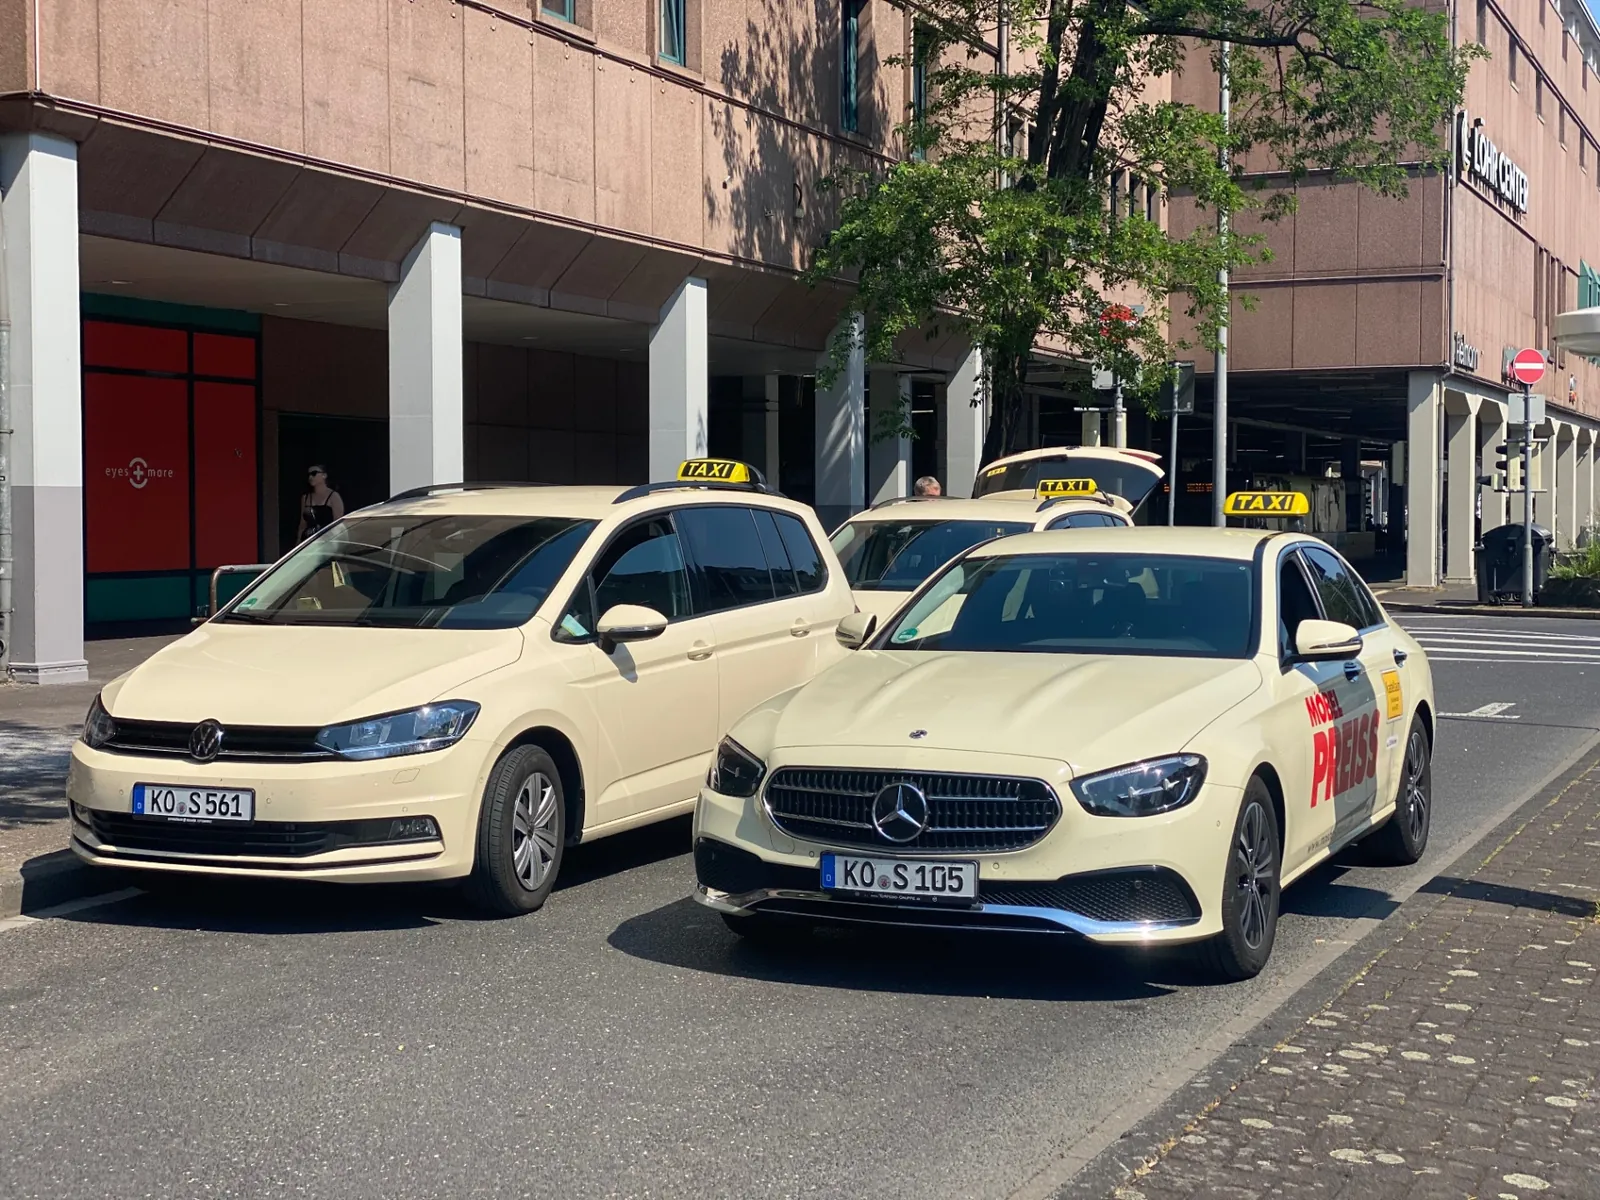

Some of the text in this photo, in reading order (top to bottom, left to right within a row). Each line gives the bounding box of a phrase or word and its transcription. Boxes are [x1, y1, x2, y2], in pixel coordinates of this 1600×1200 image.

[1499, 151, 1528, 213] CENTER
[105, 467, 173, 478] eyes more
[687, 462, 731, 478] TAXI
[1046, 480, 1083, 491] TAXI
[1236, 494, 1293, 510] TAXI
[1310, 708, 1380, 809] PREISS
[151, 789, 176, 813] KO
[844, 859, 875, 888] KO
